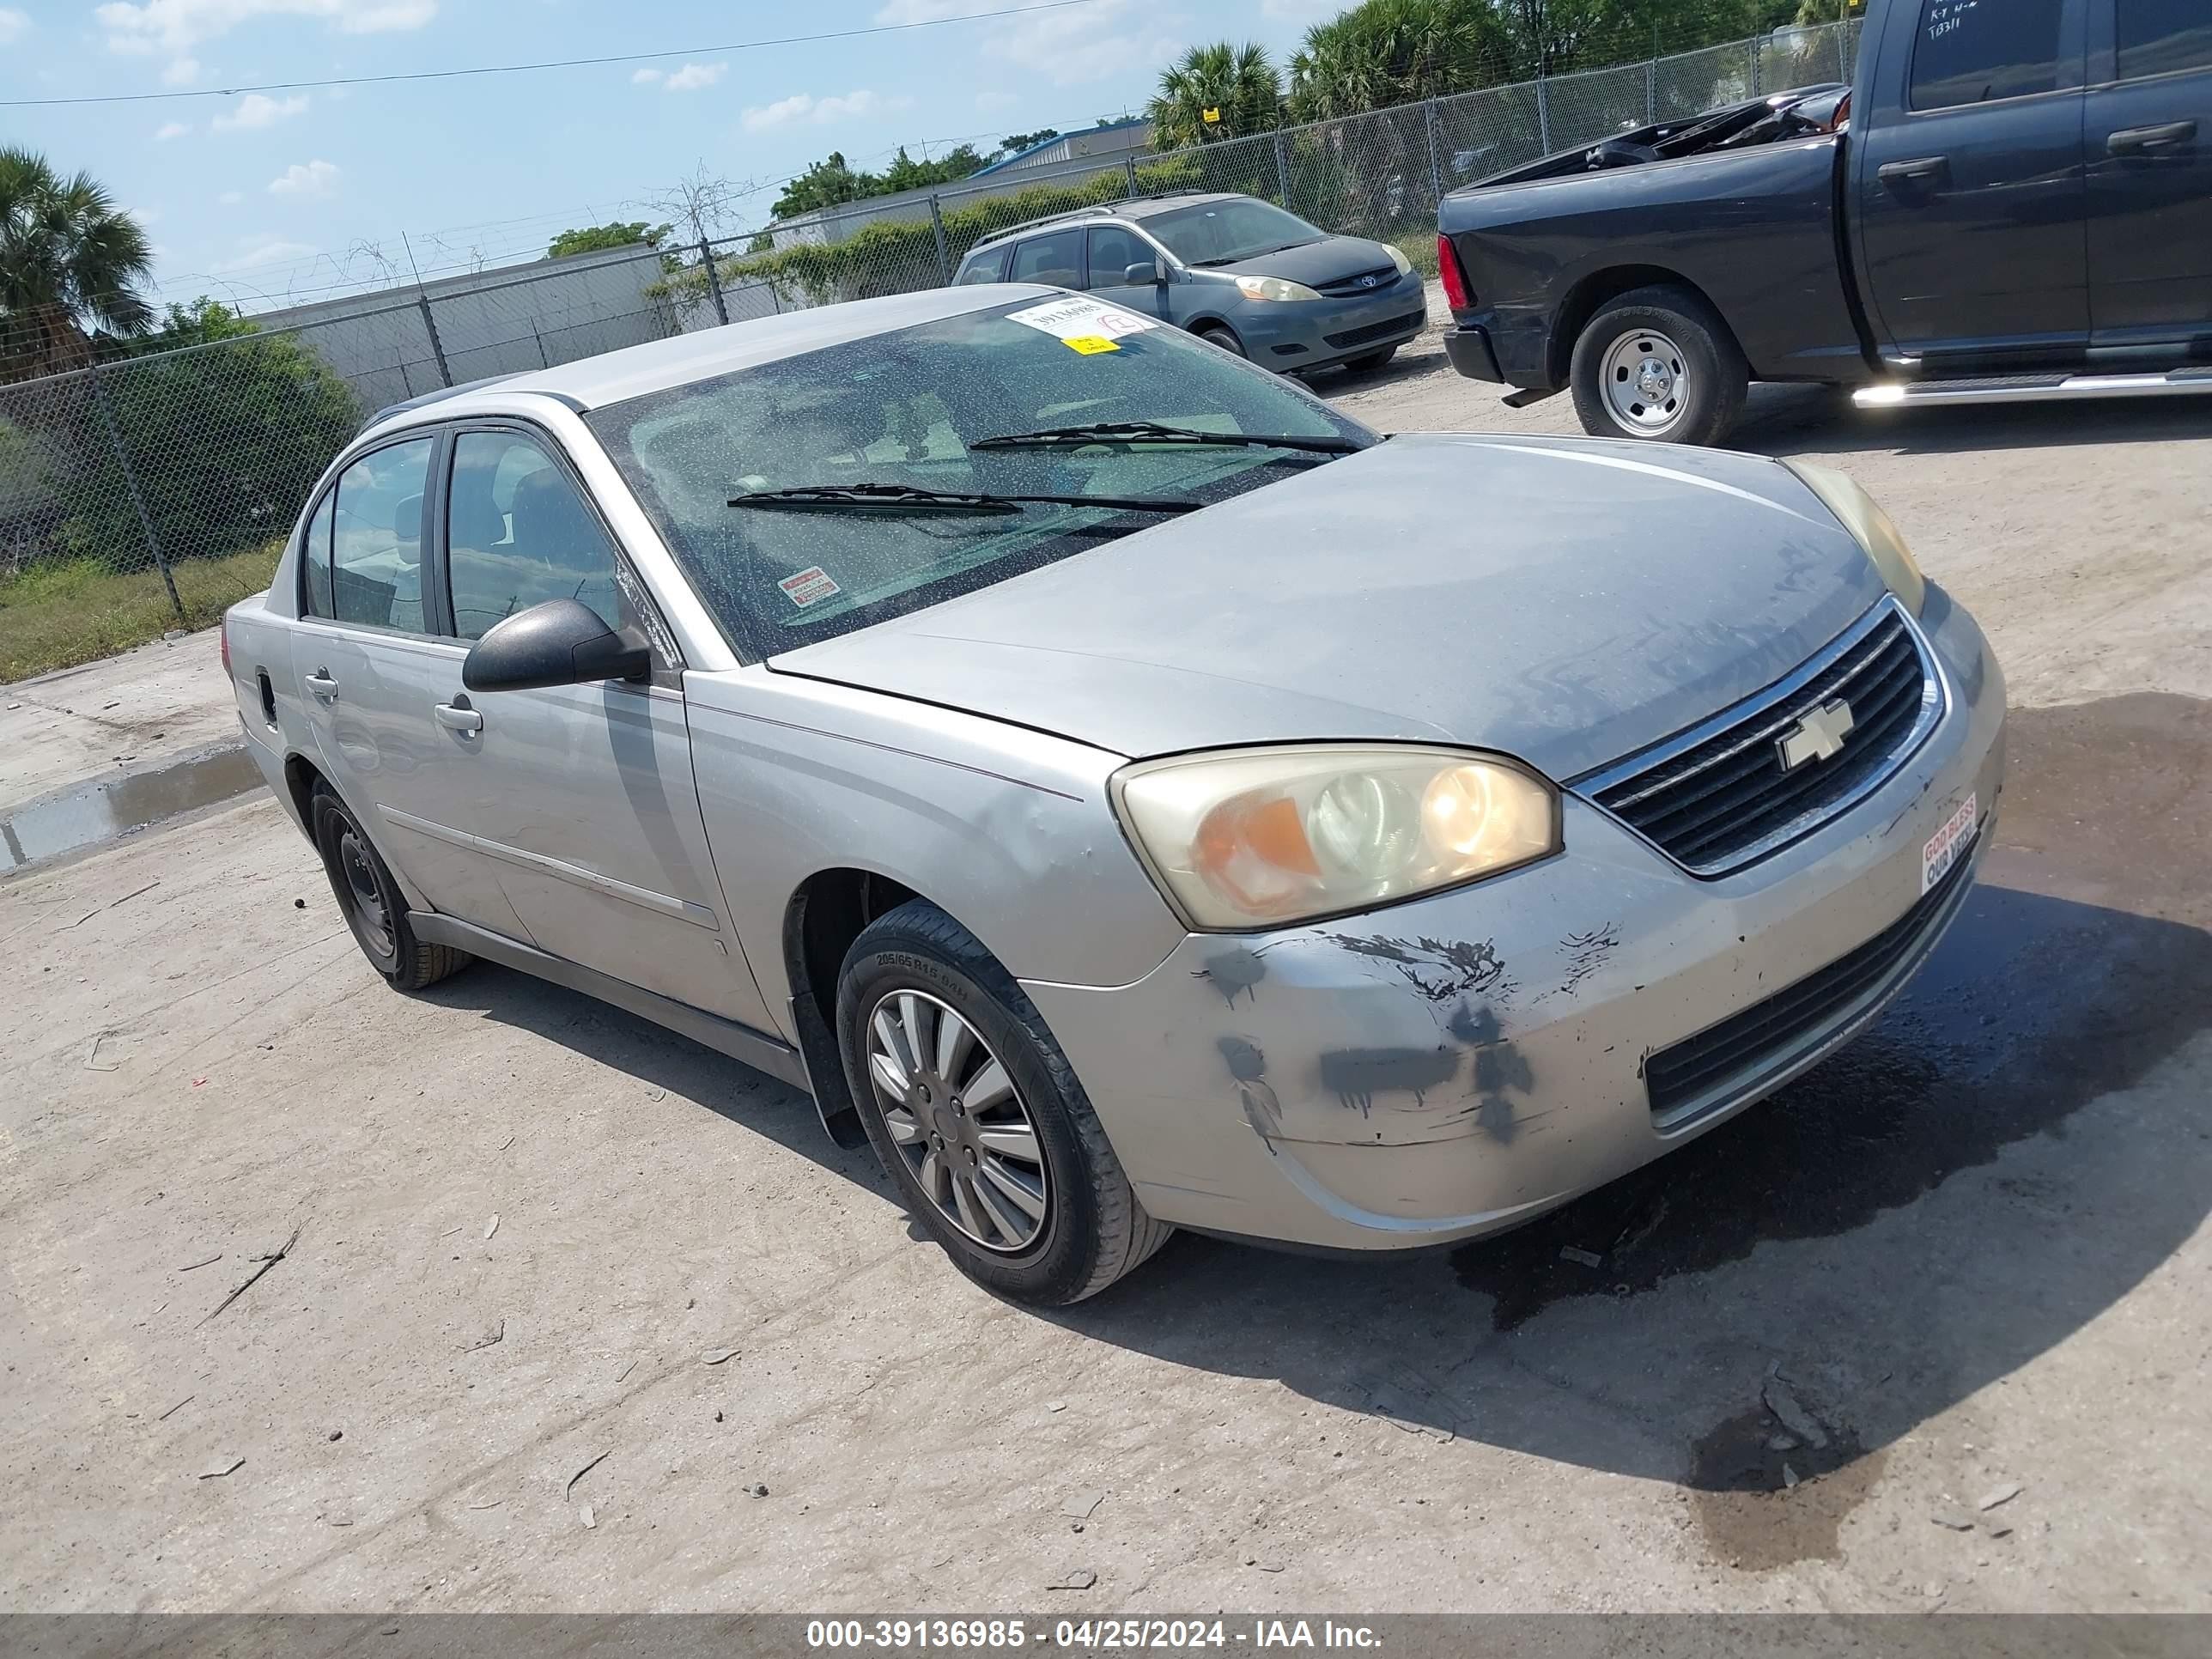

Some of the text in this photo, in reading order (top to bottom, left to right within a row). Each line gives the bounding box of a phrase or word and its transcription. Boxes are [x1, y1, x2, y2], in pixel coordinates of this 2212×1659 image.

[1033, 303, 1102, 326] 39136985
[1925, 797, 1974, 862] GOD BLESS
[1927, 850, 1948, 885] OUR
[876, 953, 912, 967] 205/65
